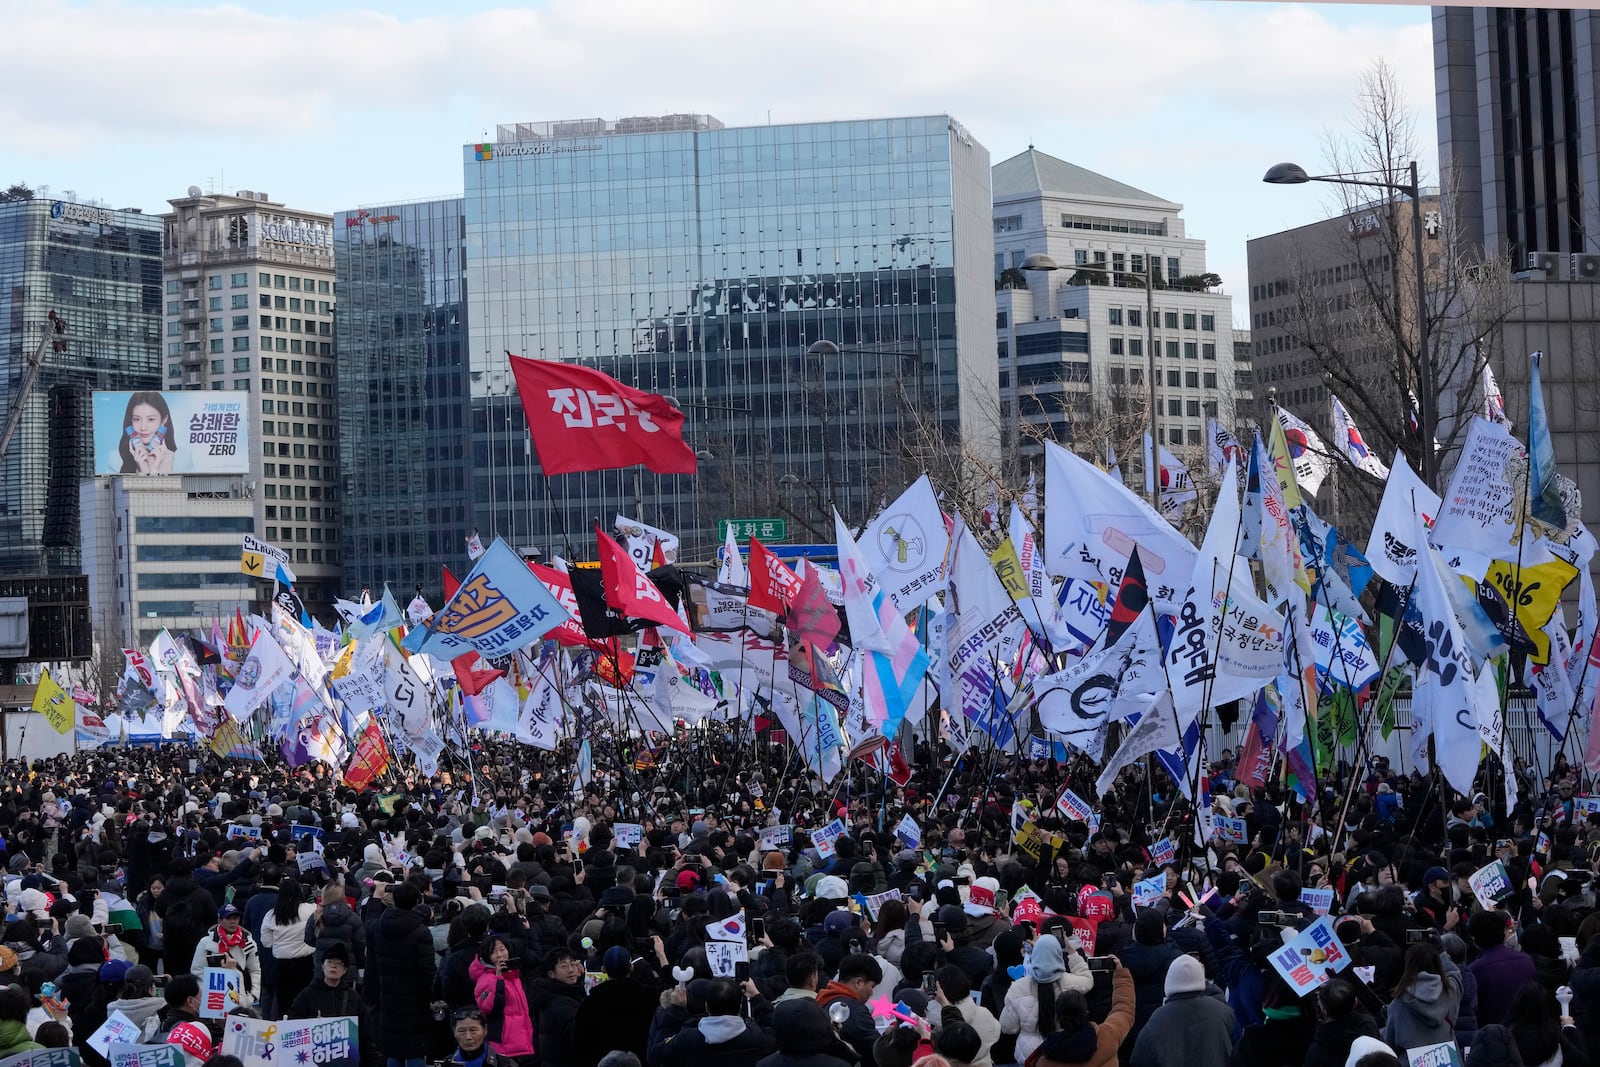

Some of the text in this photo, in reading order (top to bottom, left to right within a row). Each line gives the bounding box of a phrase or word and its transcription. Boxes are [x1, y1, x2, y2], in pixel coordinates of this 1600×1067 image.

[495, 143, 550, 157] Microsoft
[261, 222, 329, 248] SOMERSET
[190, 413, 240, 431] 상쾌환
[190, 432, 237, 444] BOOSTER
[208, 444, 236, 456] ZERO
[1212, 615, 1283, 652] 한국청년
[209, 972, 225, 990] 내
[313, 1020, 350, 1045] 해체
[282, 1036, 311, 1049] 국민의힘
[314, 1041, 350, 1064] 하라
